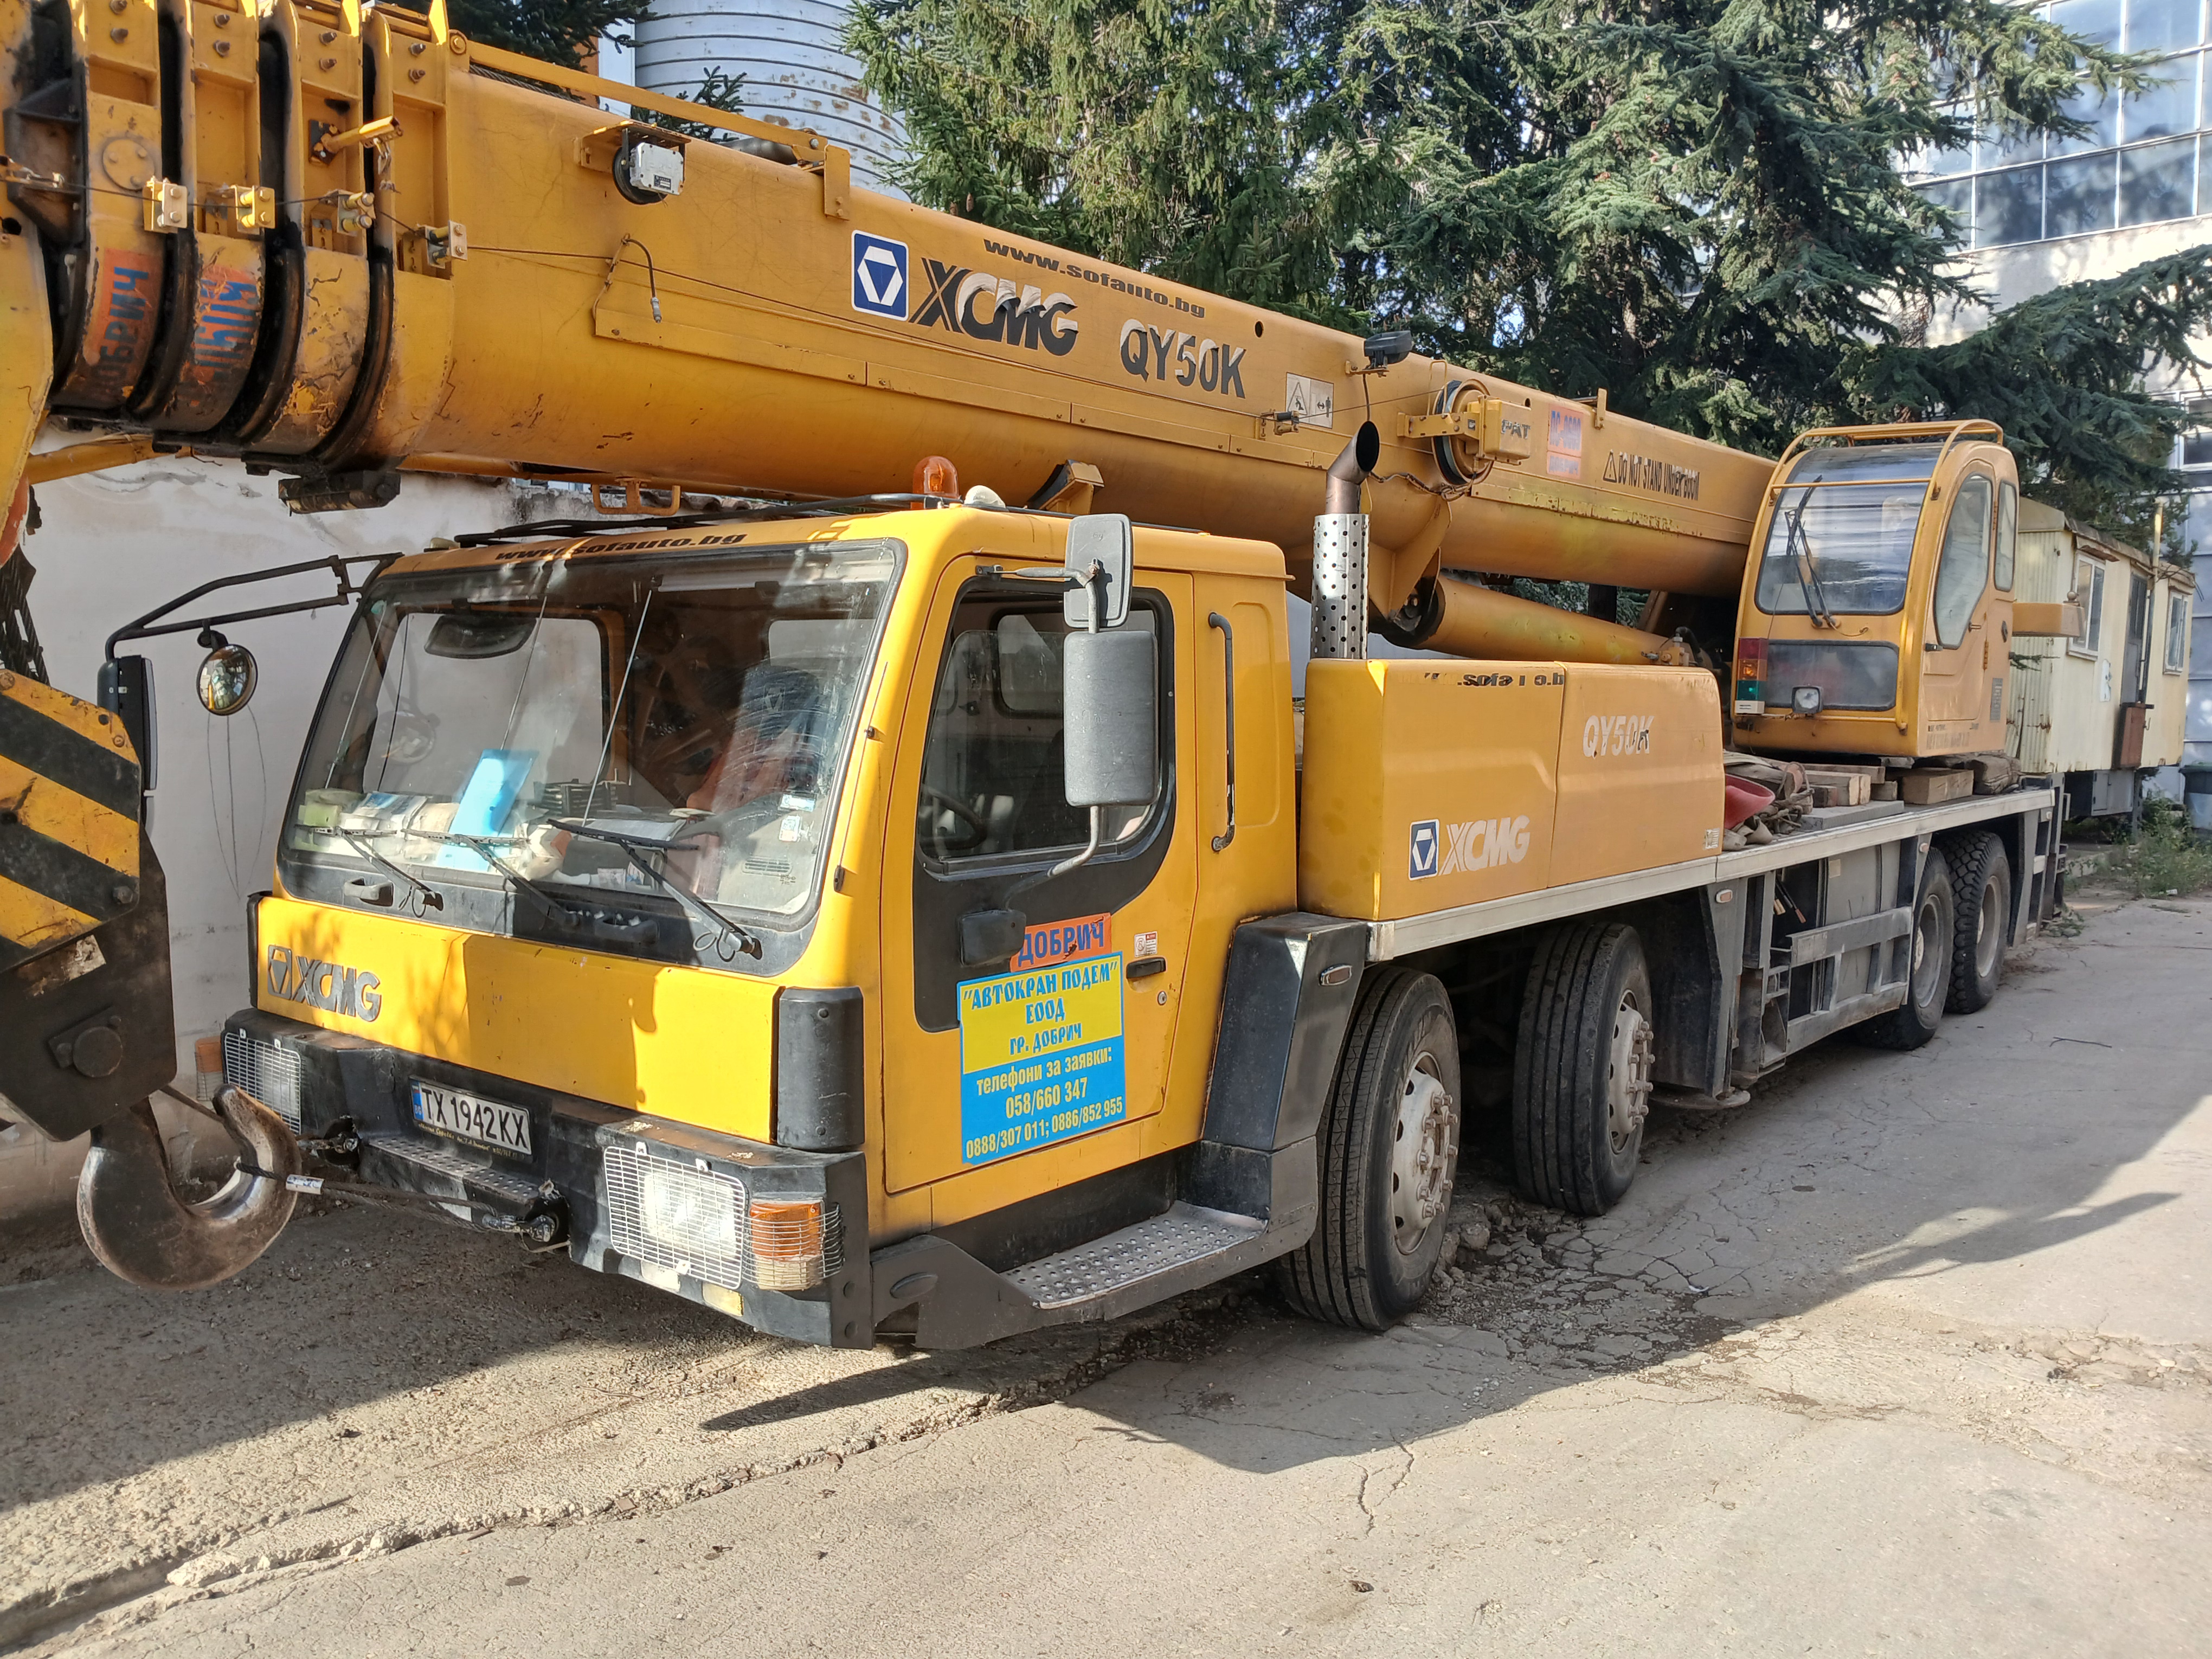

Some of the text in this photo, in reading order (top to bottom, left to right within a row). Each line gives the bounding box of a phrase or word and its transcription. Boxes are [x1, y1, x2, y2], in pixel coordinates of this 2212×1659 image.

[983, 239, 1205, 318] www.sofauto.bg
[909, 257, 1078, 356] XCMG
[1120, 319, 1246, 399] QY50K
[1501, 419, 1531, 440] PAT
[1618, 451, 1628, 485] DO
[1629, 454, 1642, 488] NOT
[1643, 457, 1663, 492] STAND
[494, 533, 748, 560] www.sofauto.bg
[1583, 715, 1655, 760] QY50K
[1438, 814, 1531, 876] XCMG
[1018, 922, 1104, 967] ДОБРИЧ
[292, 956, 382, 1023] XCMG
[963, 961, 1117, 1010] "АВТОКРАН ПОДЕМ"
[1026, 997, 1066, 1024] ЕООД
[1009, 1023, 1082, 1056] ГР. ДОБРИЧ
[976, 1047, 1113, 1096] телефони за заявки:
[414, 1104, 422, 1115] BG
[1006, 1076, 1088, 1119] 058/660 347
[966, 1096, 1123, 1159] 0888/307 011; 0886/852 955
